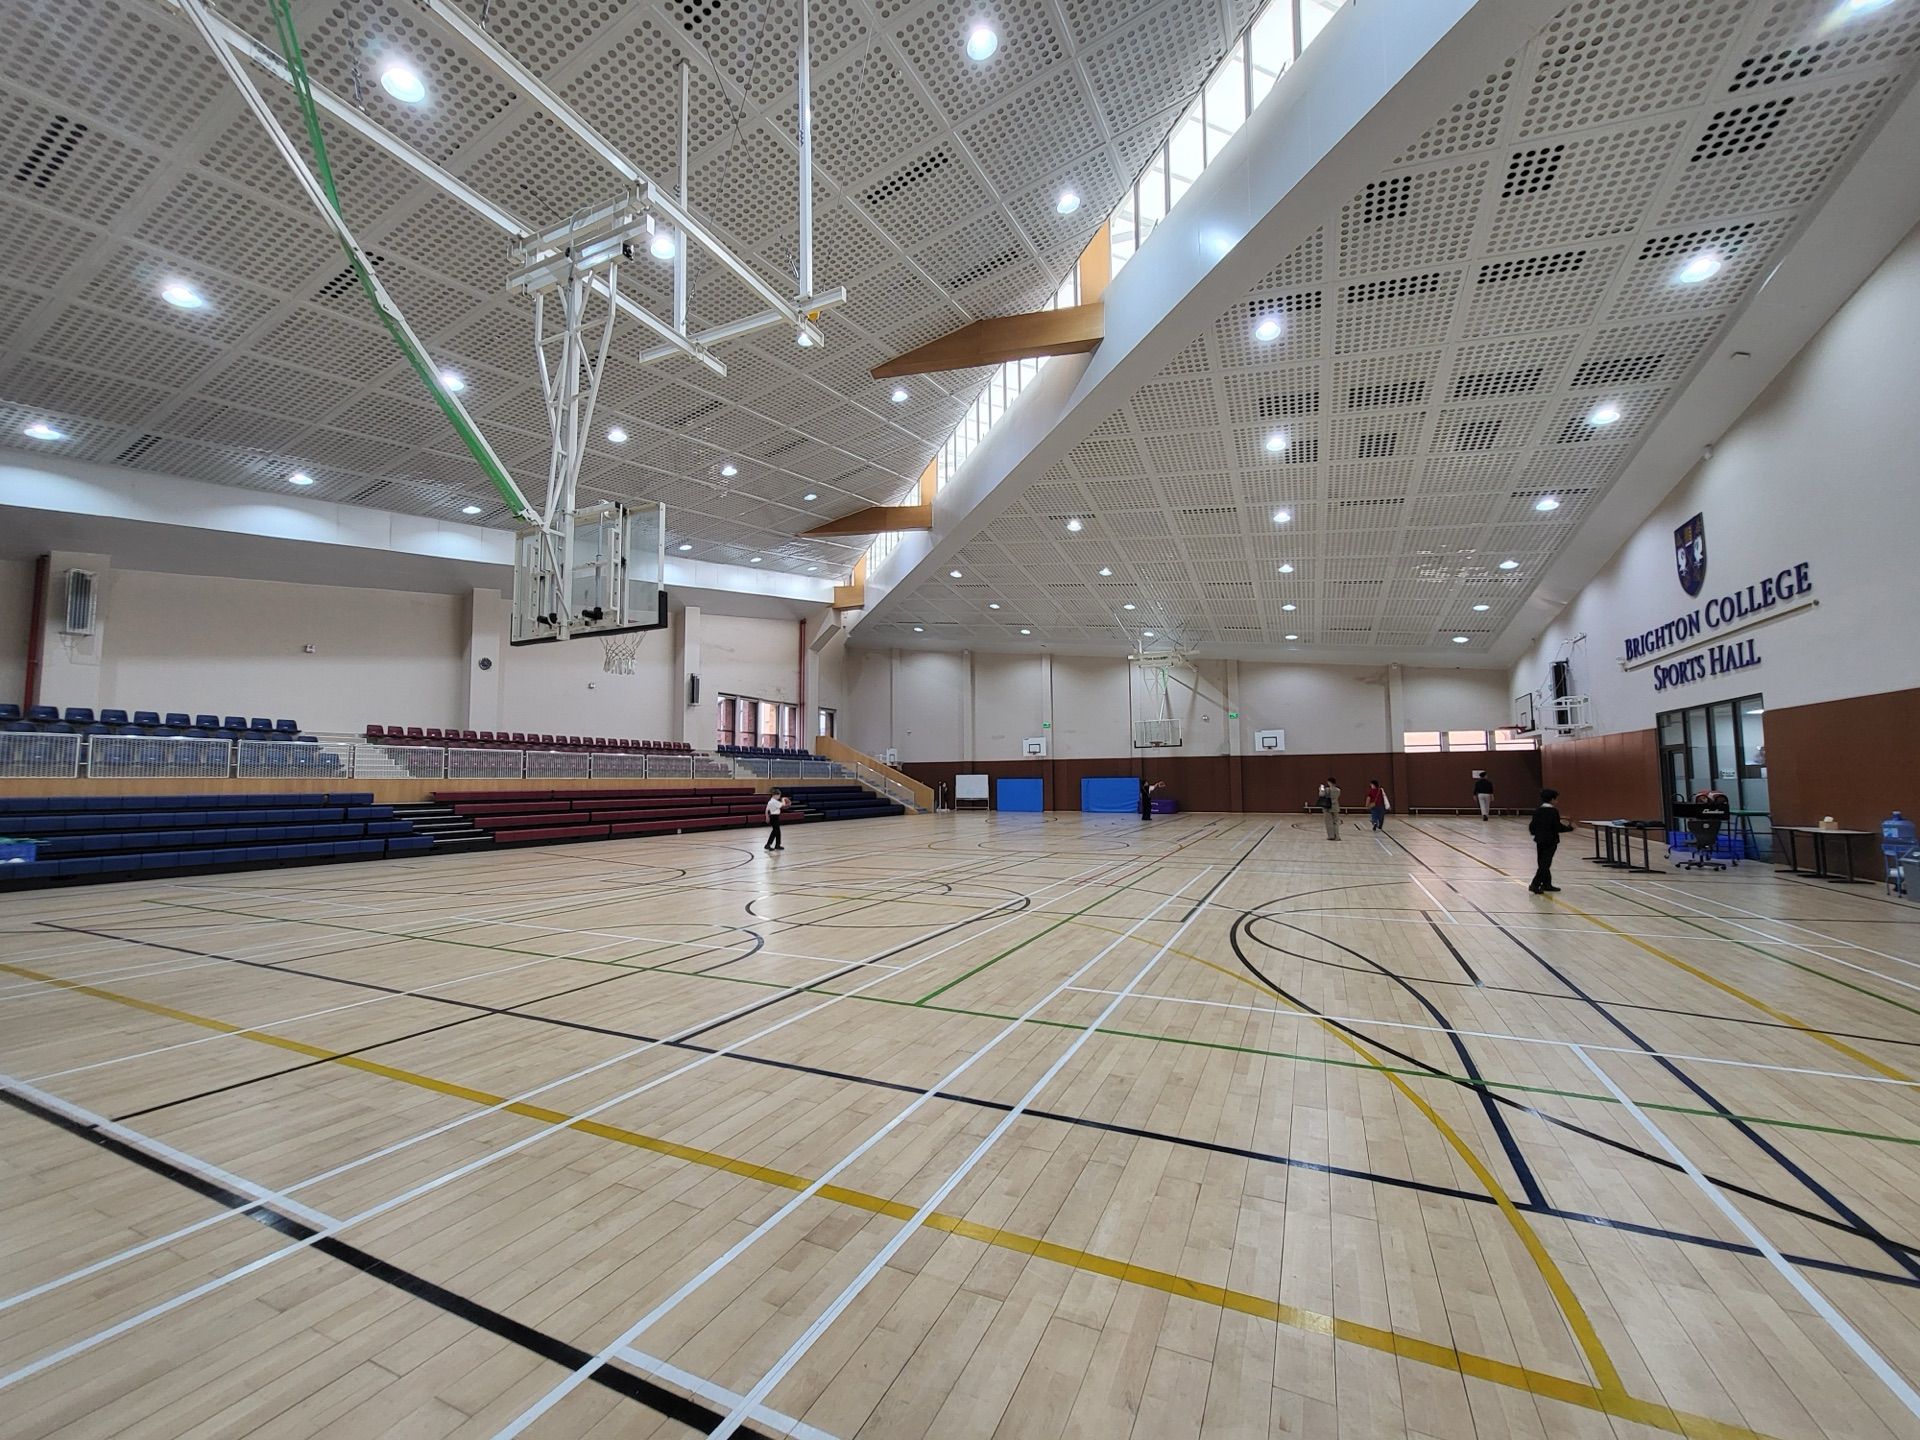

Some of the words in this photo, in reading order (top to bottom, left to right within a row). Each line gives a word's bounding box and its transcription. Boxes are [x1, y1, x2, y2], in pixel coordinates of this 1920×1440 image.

[1624, 610, 1700, 661] BRIGHTON
[1705, 562, 1812, 628] COLLEGE
[1654, 655, 1706, 691] SPORTS
[1708, 639, 1761, 675] HALL
